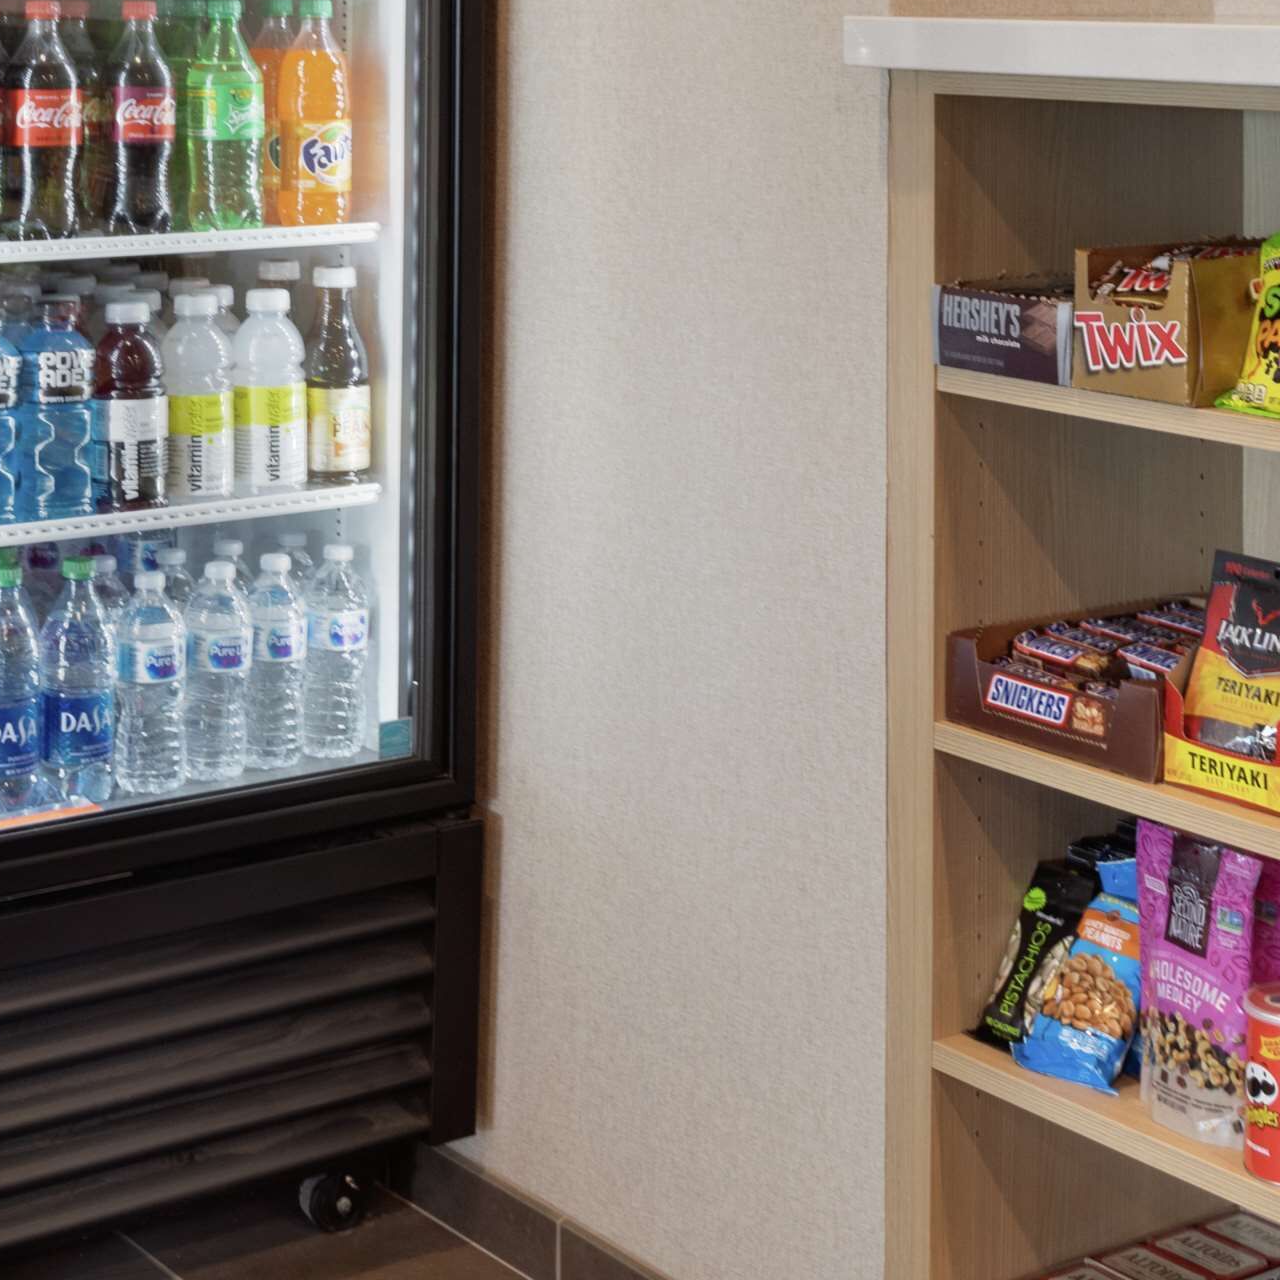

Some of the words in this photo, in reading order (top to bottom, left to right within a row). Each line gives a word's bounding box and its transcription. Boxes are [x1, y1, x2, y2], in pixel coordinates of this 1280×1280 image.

[942, 293, 1022, 339] HERSHEY'S
[1217, 620, 1252, 647] JACK
[990, 676, 1067, 723] SNICKERS
[1187, 751, 1269, 791] TERIYAKI
[1083, 926, 1124, 951] PEANUTS
[999, 921, 1053, 1017] PISTACHIOS
[1156, 981, 1203, 1015] MEDLEY
[1177, 1234, 1242, 1268] ALTOIDS
